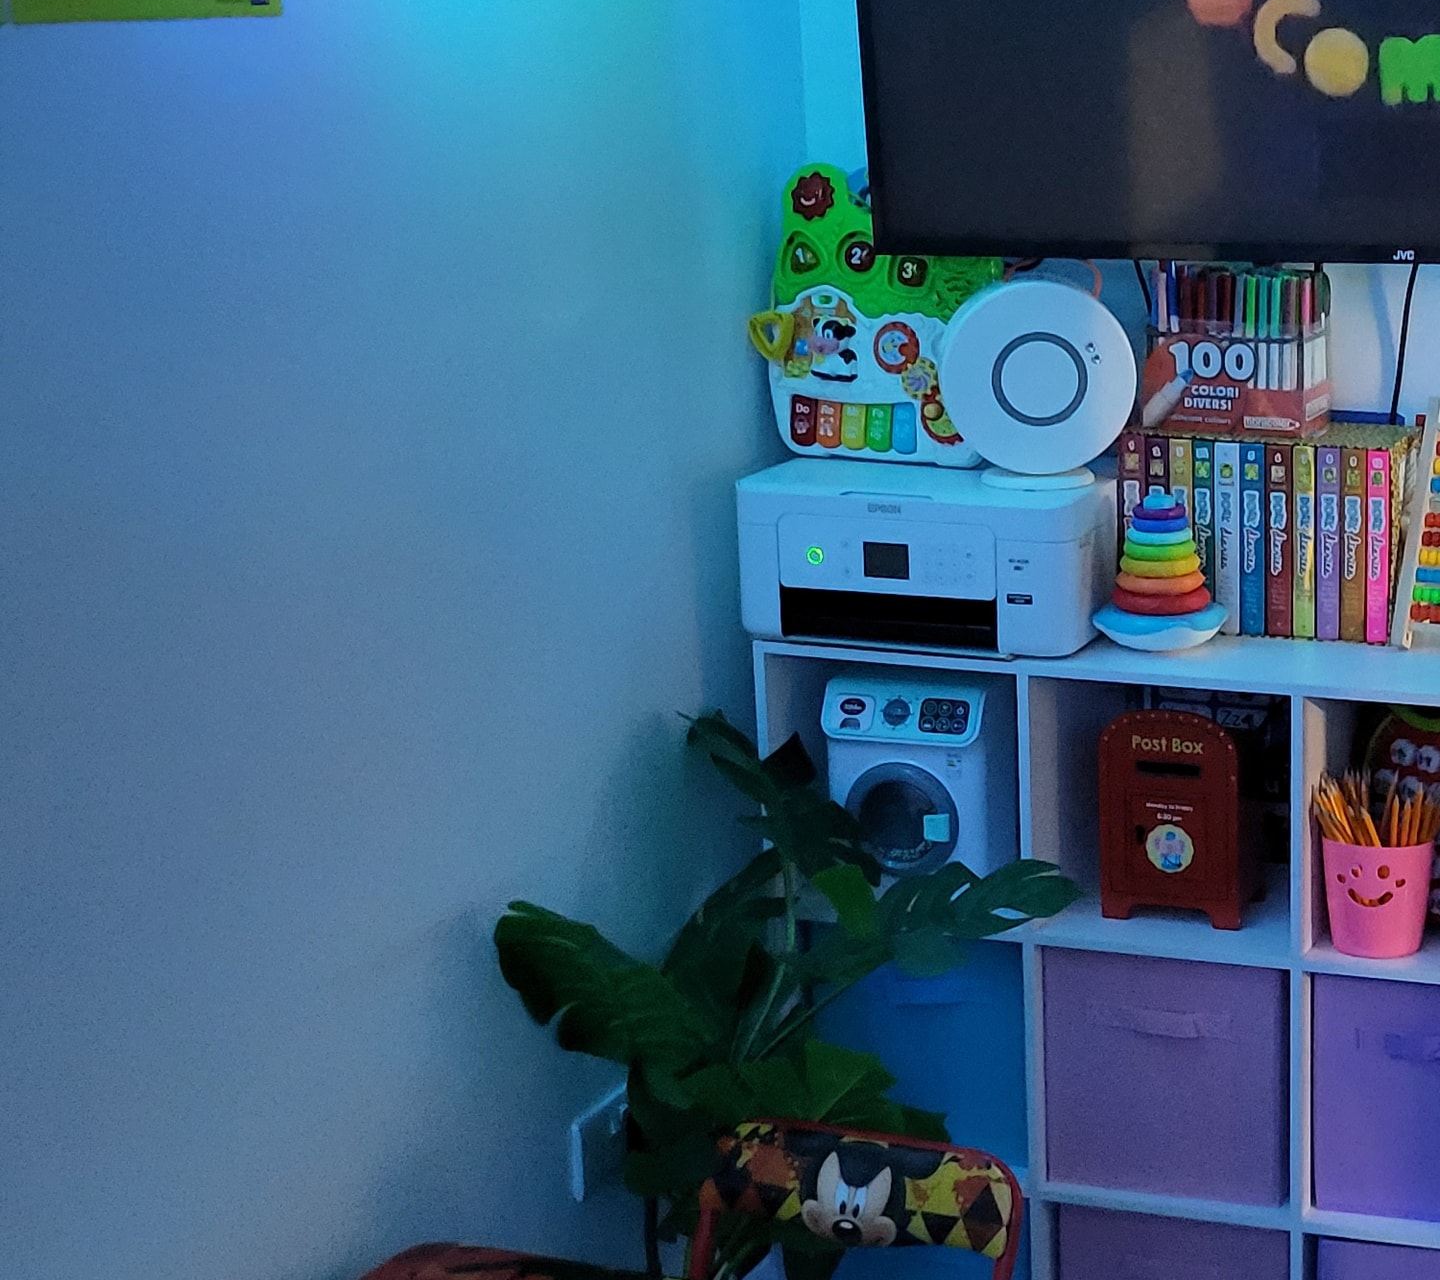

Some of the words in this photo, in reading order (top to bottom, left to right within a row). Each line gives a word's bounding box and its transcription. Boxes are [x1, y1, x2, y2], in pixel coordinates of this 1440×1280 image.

[852, 247, 862, 265] 2
[902, 261, 912, 278] 3
[1169, 341, 1256, 381] 100
[795, 403, 811, 415] Do
[1183, 397, 1232, 411] DIVERSI
[1131, 734, 1168, 753] Post
[1171, 737, 1205, 756] Box
